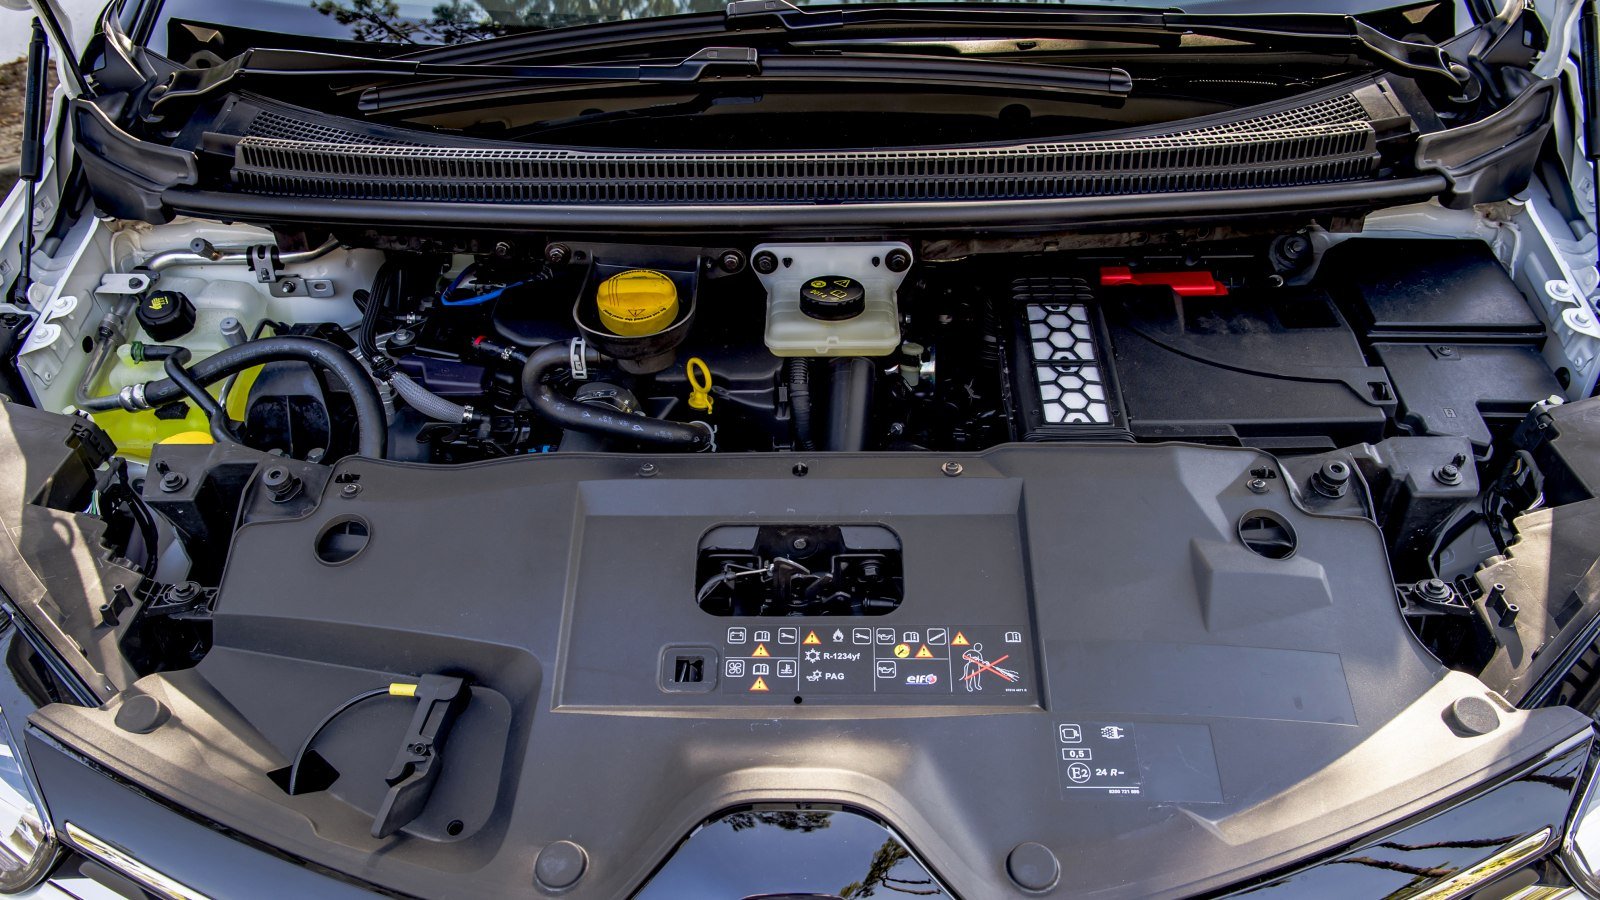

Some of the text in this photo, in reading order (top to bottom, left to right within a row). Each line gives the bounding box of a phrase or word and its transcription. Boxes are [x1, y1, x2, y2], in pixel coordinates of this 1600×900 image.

[823, 652, 861, 662] R-1234yf
[825, 672, 845, 680] PAG
[1069, 750, 1085, 759] 0,5
[1071, 767, 1089, 779] E2
[1095, 768, 1108, 776] 24
